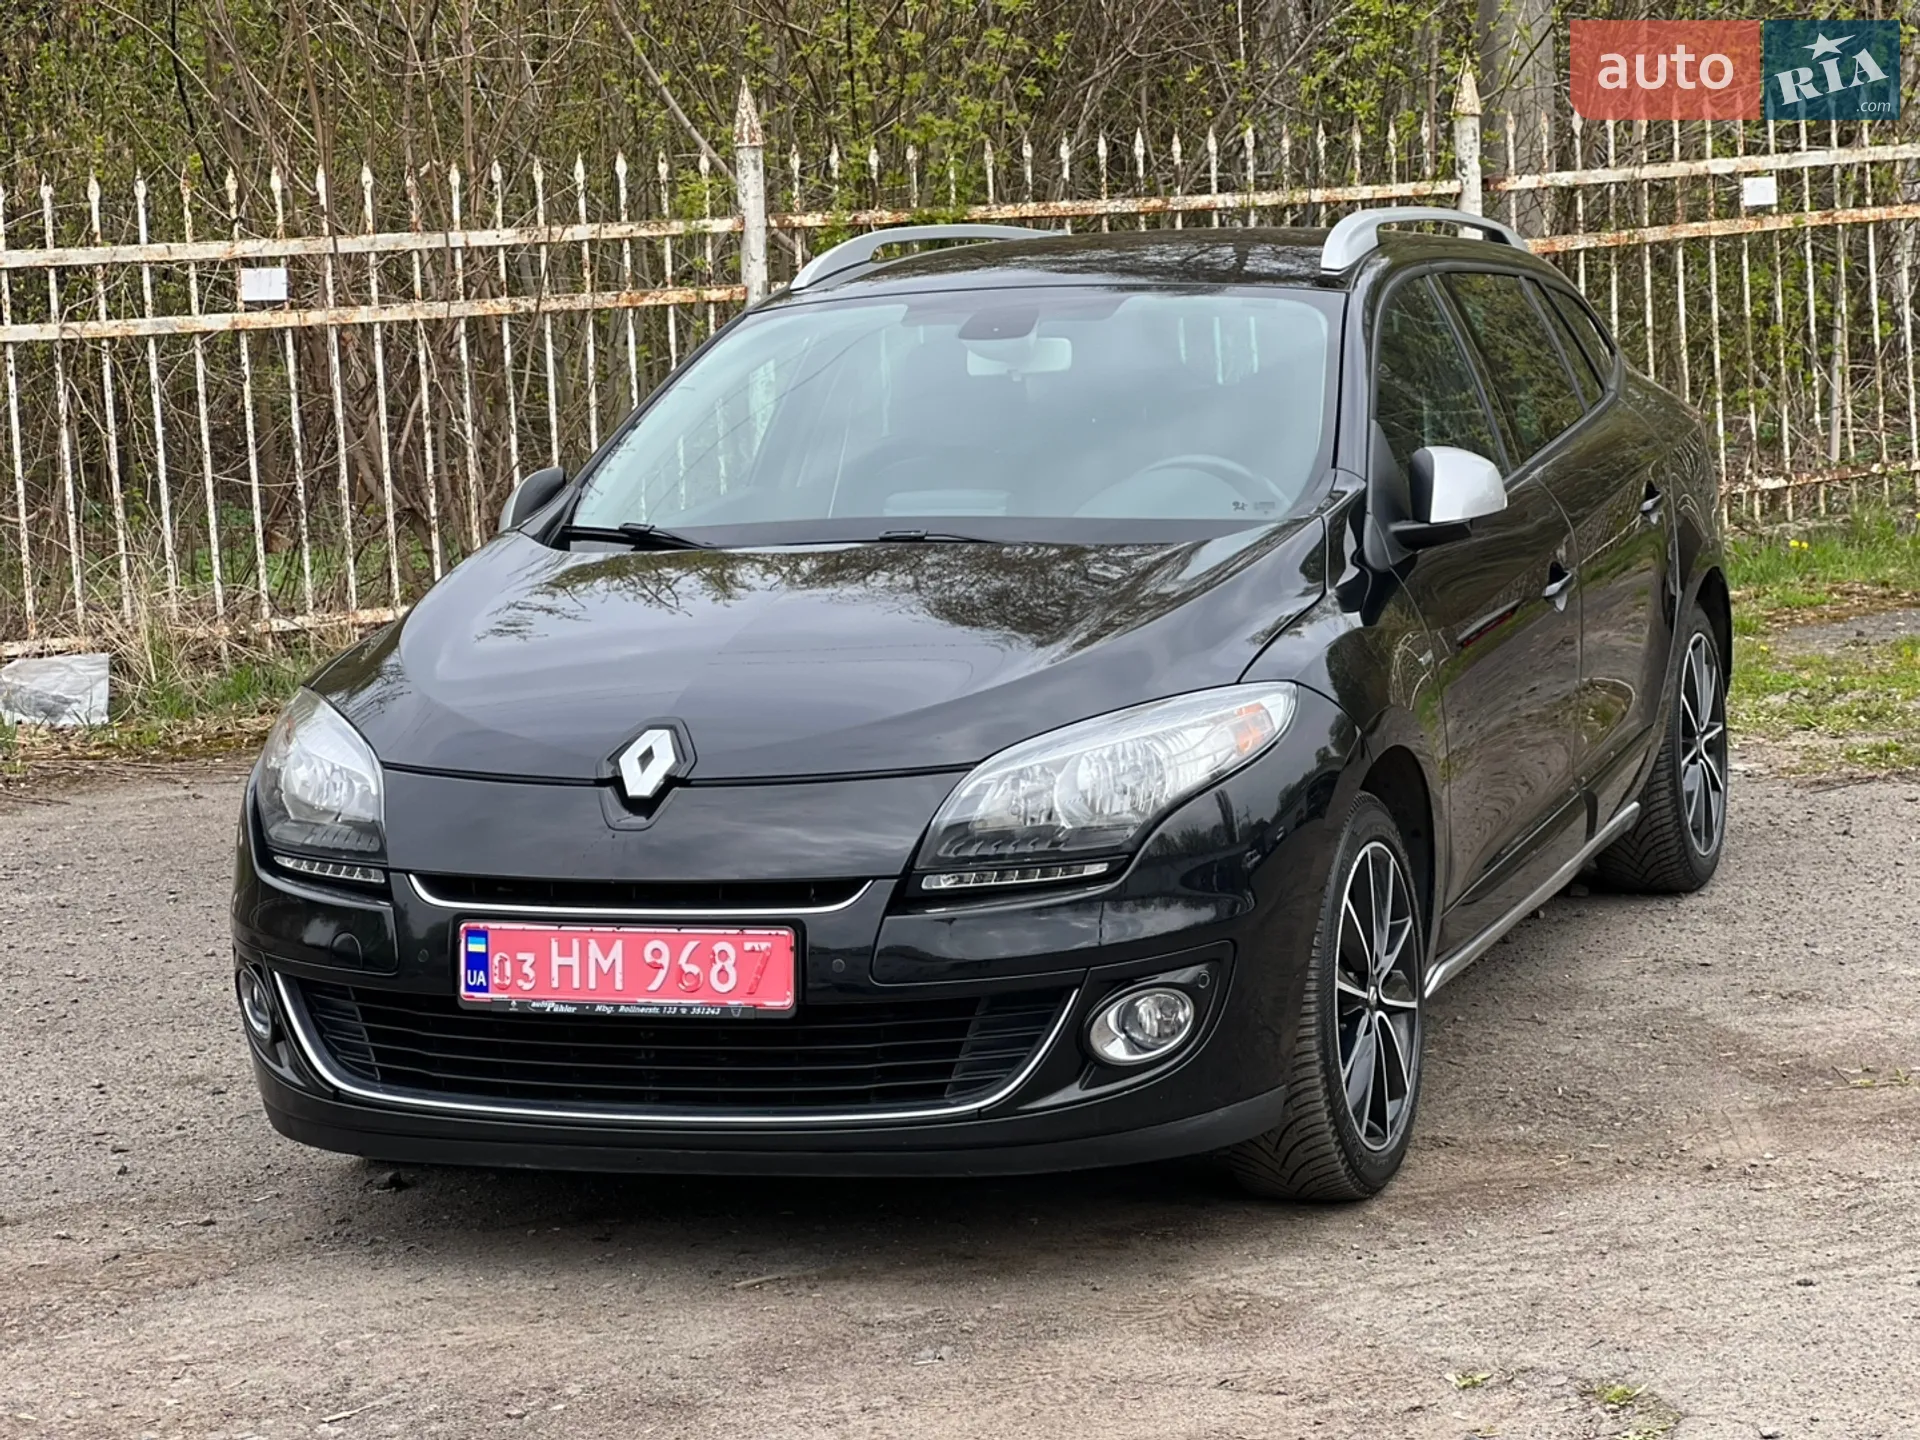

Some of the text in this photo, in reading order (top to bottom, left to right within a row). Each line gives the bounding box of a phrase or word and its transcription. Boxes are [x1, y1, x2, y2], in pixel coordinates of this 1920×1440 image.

[467, 969, 487, 987] UA
[491, 937, 773, 995] 03 HM 9687
